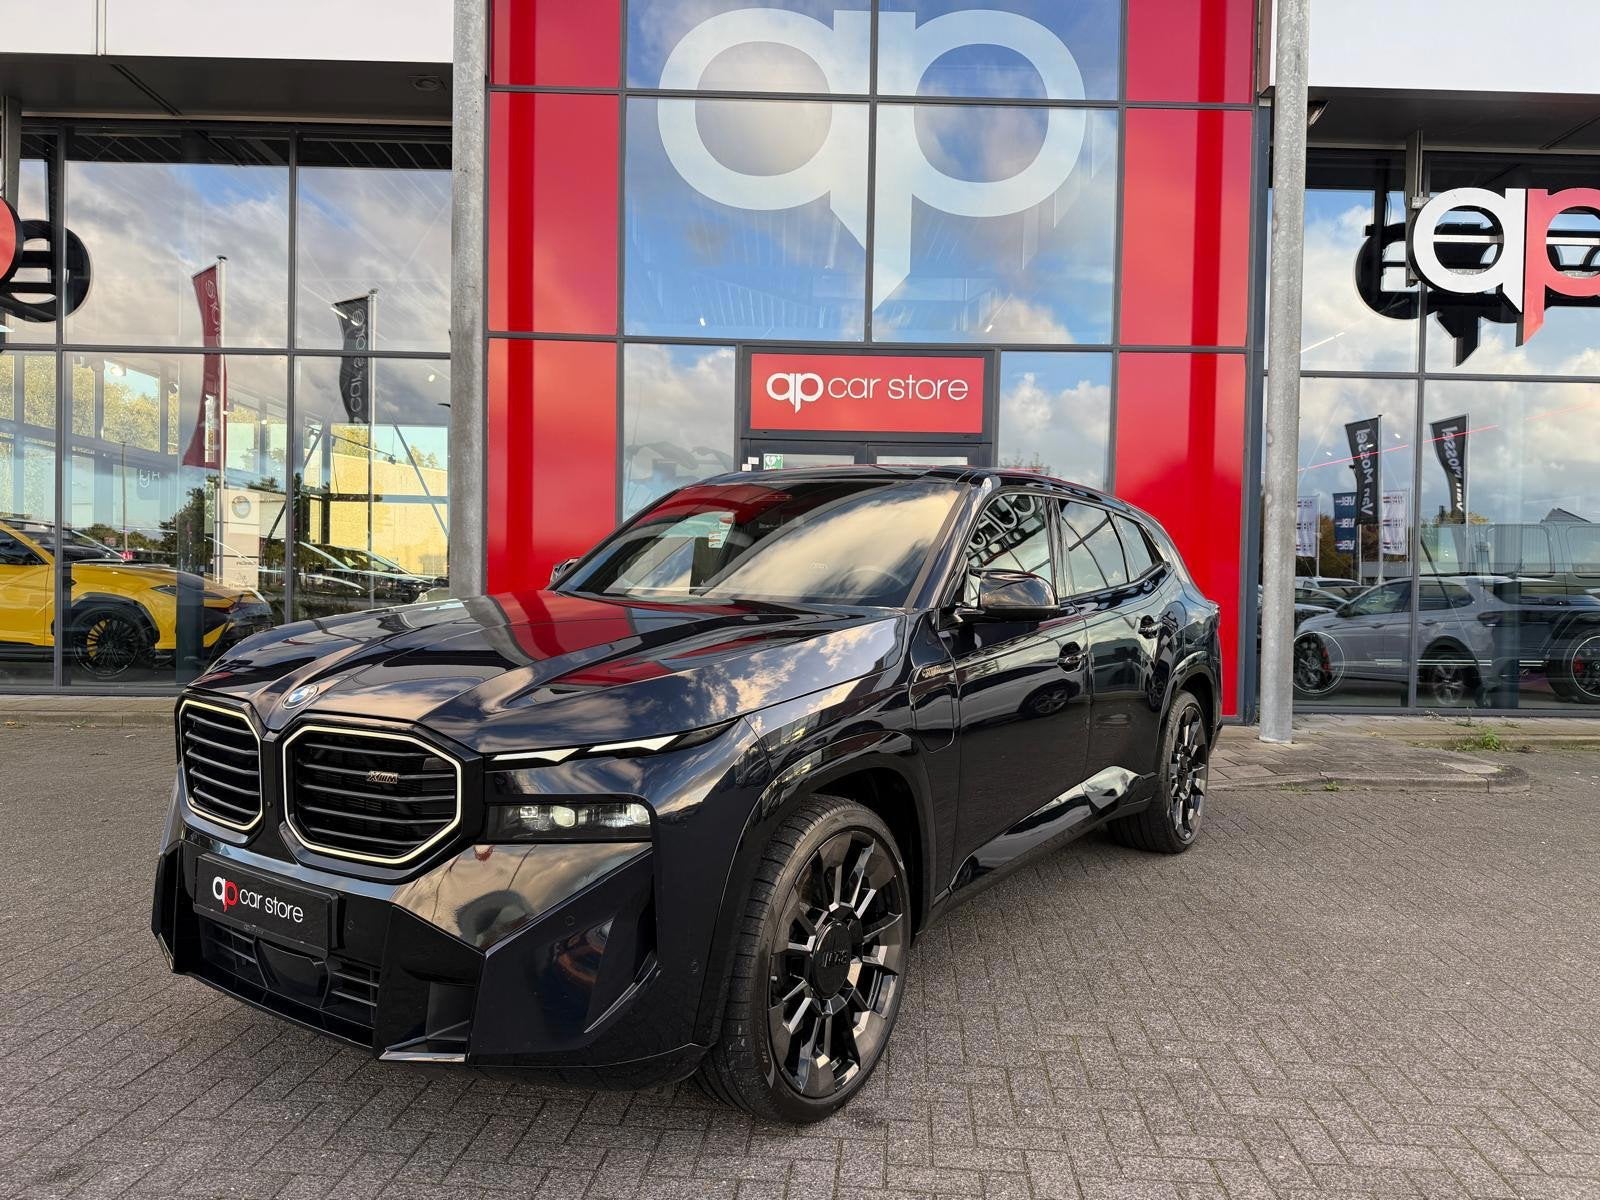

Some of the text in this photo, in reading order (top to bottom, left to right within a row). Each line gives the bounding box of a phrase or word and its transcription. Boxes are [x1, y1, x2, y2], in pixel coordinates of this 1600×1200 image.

[766, 373, 969, 414] ap car store
[212, 876, 304, 923] ap car store
